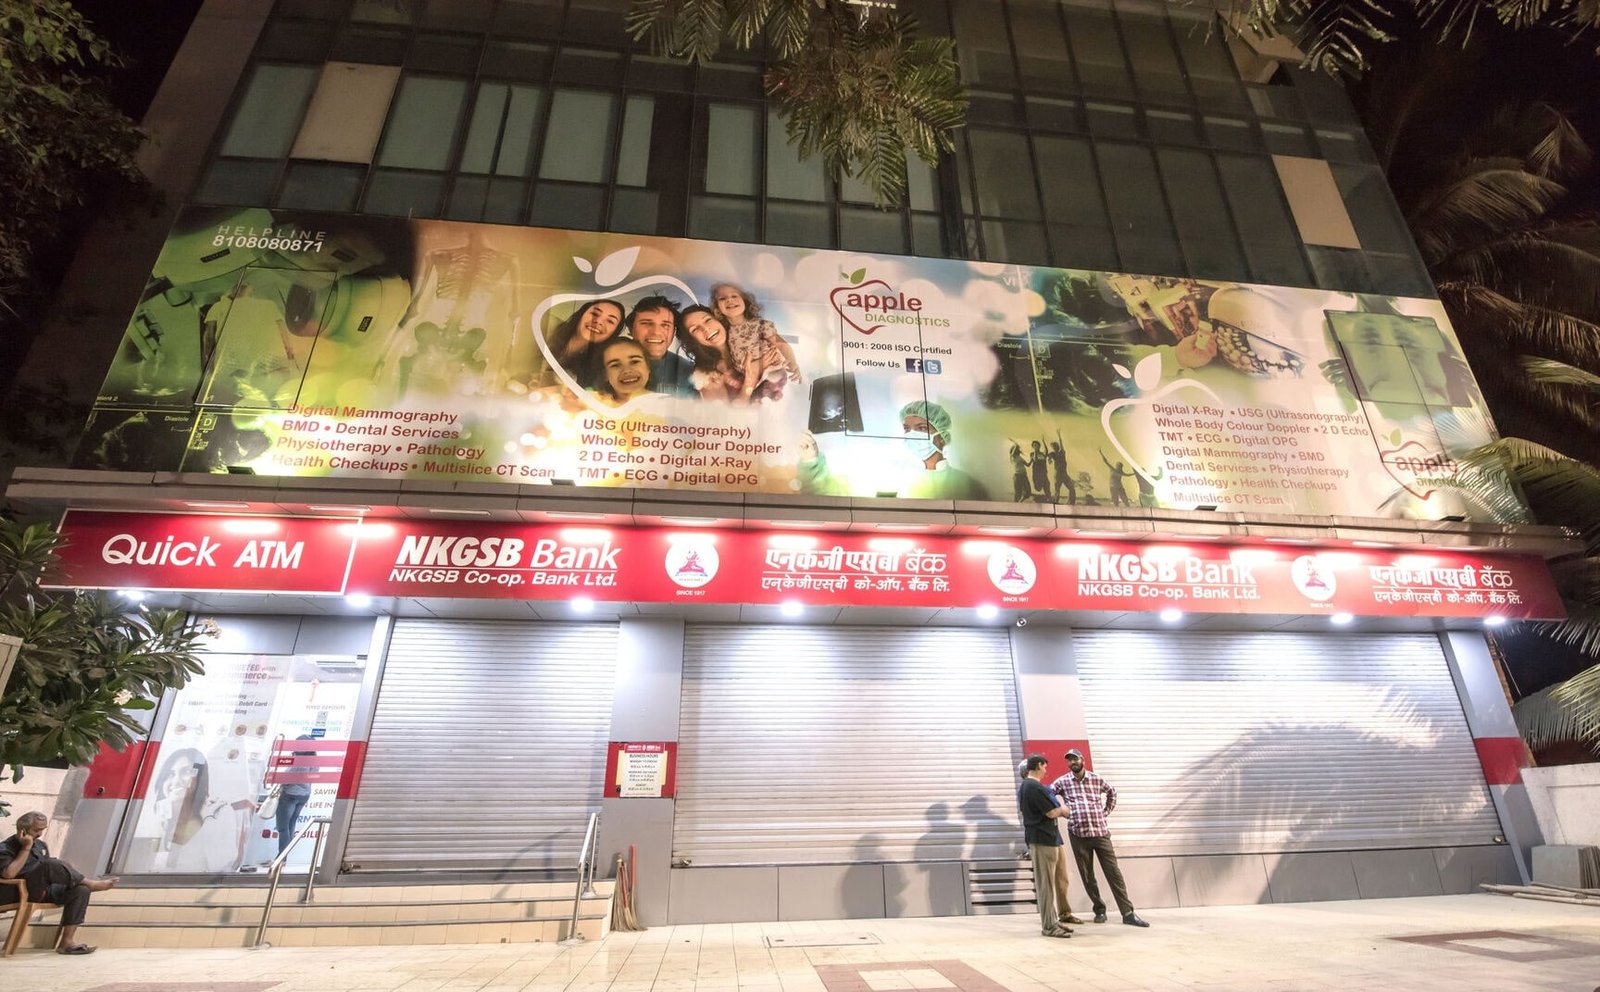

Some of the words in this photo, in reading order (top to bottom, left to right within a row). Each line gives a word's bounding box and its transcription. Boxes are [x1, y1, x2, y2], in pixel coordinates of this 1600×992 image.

[218, 225, 327, 241] HELPLINE
[212, 235, 323, 253] 8108080871
[847, 292, 922, 313] apple
[865, 313, 951, 328] DIAGNOSTICS
[842, 341, 868, 350] 9001:
[871, 343, 893, 351] 2008
[895, 344, 911, 353] ISO
[856, 358, 886, 368] Follow
[888, 360, 901, 369] Us
[287, 403, 339, 418] Digital
[342, 406, 458, 425] Mammography
[1152, 404, 1190, 416] Digital
[1192, 406, 1224, 418] X-Ray
[1238, 408, 1264, 418] USG
[1266, 409, 1364, 425] (Ultrasonography)
[282, 419, 320, 432] BMD
[335, 422, 388, 436] Dental
[391, 425, 459, 439] Services
[583, 418, 616, 431] USG
[620, 420, 751, 439] (Ultrasonography)
[1155, 417, 1192, 429] Whole
[1195, 419, 1224, 432] Body
[1226, 421, 1264, 432] Colour
[1267, 423, 1310, 436] Doppler
[1321, 426, 1328, 434] 2
[1330, 426, 1339, 435] D
[1341, 426, 1369, 437] Echo
[276, 436, 392, 456] Physiotherapy
[407, 442, 486, 459] Pathology
[581, 434, 627, 447] Whole
[631, 436, 669, 451] Body
[672, 438, 721, 451] Colour
[725, 441, 782, 454] Doppler
[1158, 431, 1184, 442] TMT
[1196, 433, 1222, 443] ECG
[1233, 435, 1270, 447] Digital
[1272, 437, 1298, 447] OPG
[579, 450, 588, 461] 2
[592, 451, 603, 462] D
[607, 452, 645, 464] Echo
[660, 454, 707, 468] Digital
[710, 456, 752, 471] X-Ray
[1163, 445, 1201, 459] Digital
[1203, 447, 1288, 463] Mammography
[1299, 451, 1325, 461] BMD
[272, 454, 324, 467] Health
[329, 456, 409, 474] Checkups
[423, 461, 492, 475] Multislice
[496, 464, 517, 477] CT
[520, 465, 556, 478] Scan
[1166, 460, 1205, 472] Dental
[1208, 462, 1259, 473] Services
[1269, 464, 1349, 479] Physiotherapy
[1395, 454, 1458, 476] apple
[577, 467, 610, 479] TMT
[624, 469, 658, 482] ECG
[673, 471, 721, 486] Digital
[724, 473, 758, 486] OPG
[1170, 475, 1229, 489] Pathology
[1240, 478, 1279, 489] Health
[1281, 479, 1338, 492] Checkups
[1173, 491, 1231, 504] Multislice
[1234, 494, 1250, 505] CT
[1254, 495, 1285, 506] Scan
[102, 534, 221, 567] Quick
[233, 540, 304, 569] ATM
[395, 535, 525, 568] NKGSB
[531, 539, 622, 569] Bank
[388, 569, 459, 583] NKGSB
[464, 570, 526, 587] Co-op.
[532, 573, 580, 586] Bank
[583, 575, 617, 587] Ltd.
[1078, 553, 1178, 582] NKGSB
[1185, 556, 1257, 584] Bank
[1078, 584, 1133, 596] NKGSB
[1138, 585, 1188, 600] Co-op.
[1193, 587, 1229, 599] Bank
[1234, 587, 1261, 600] Ltd.
